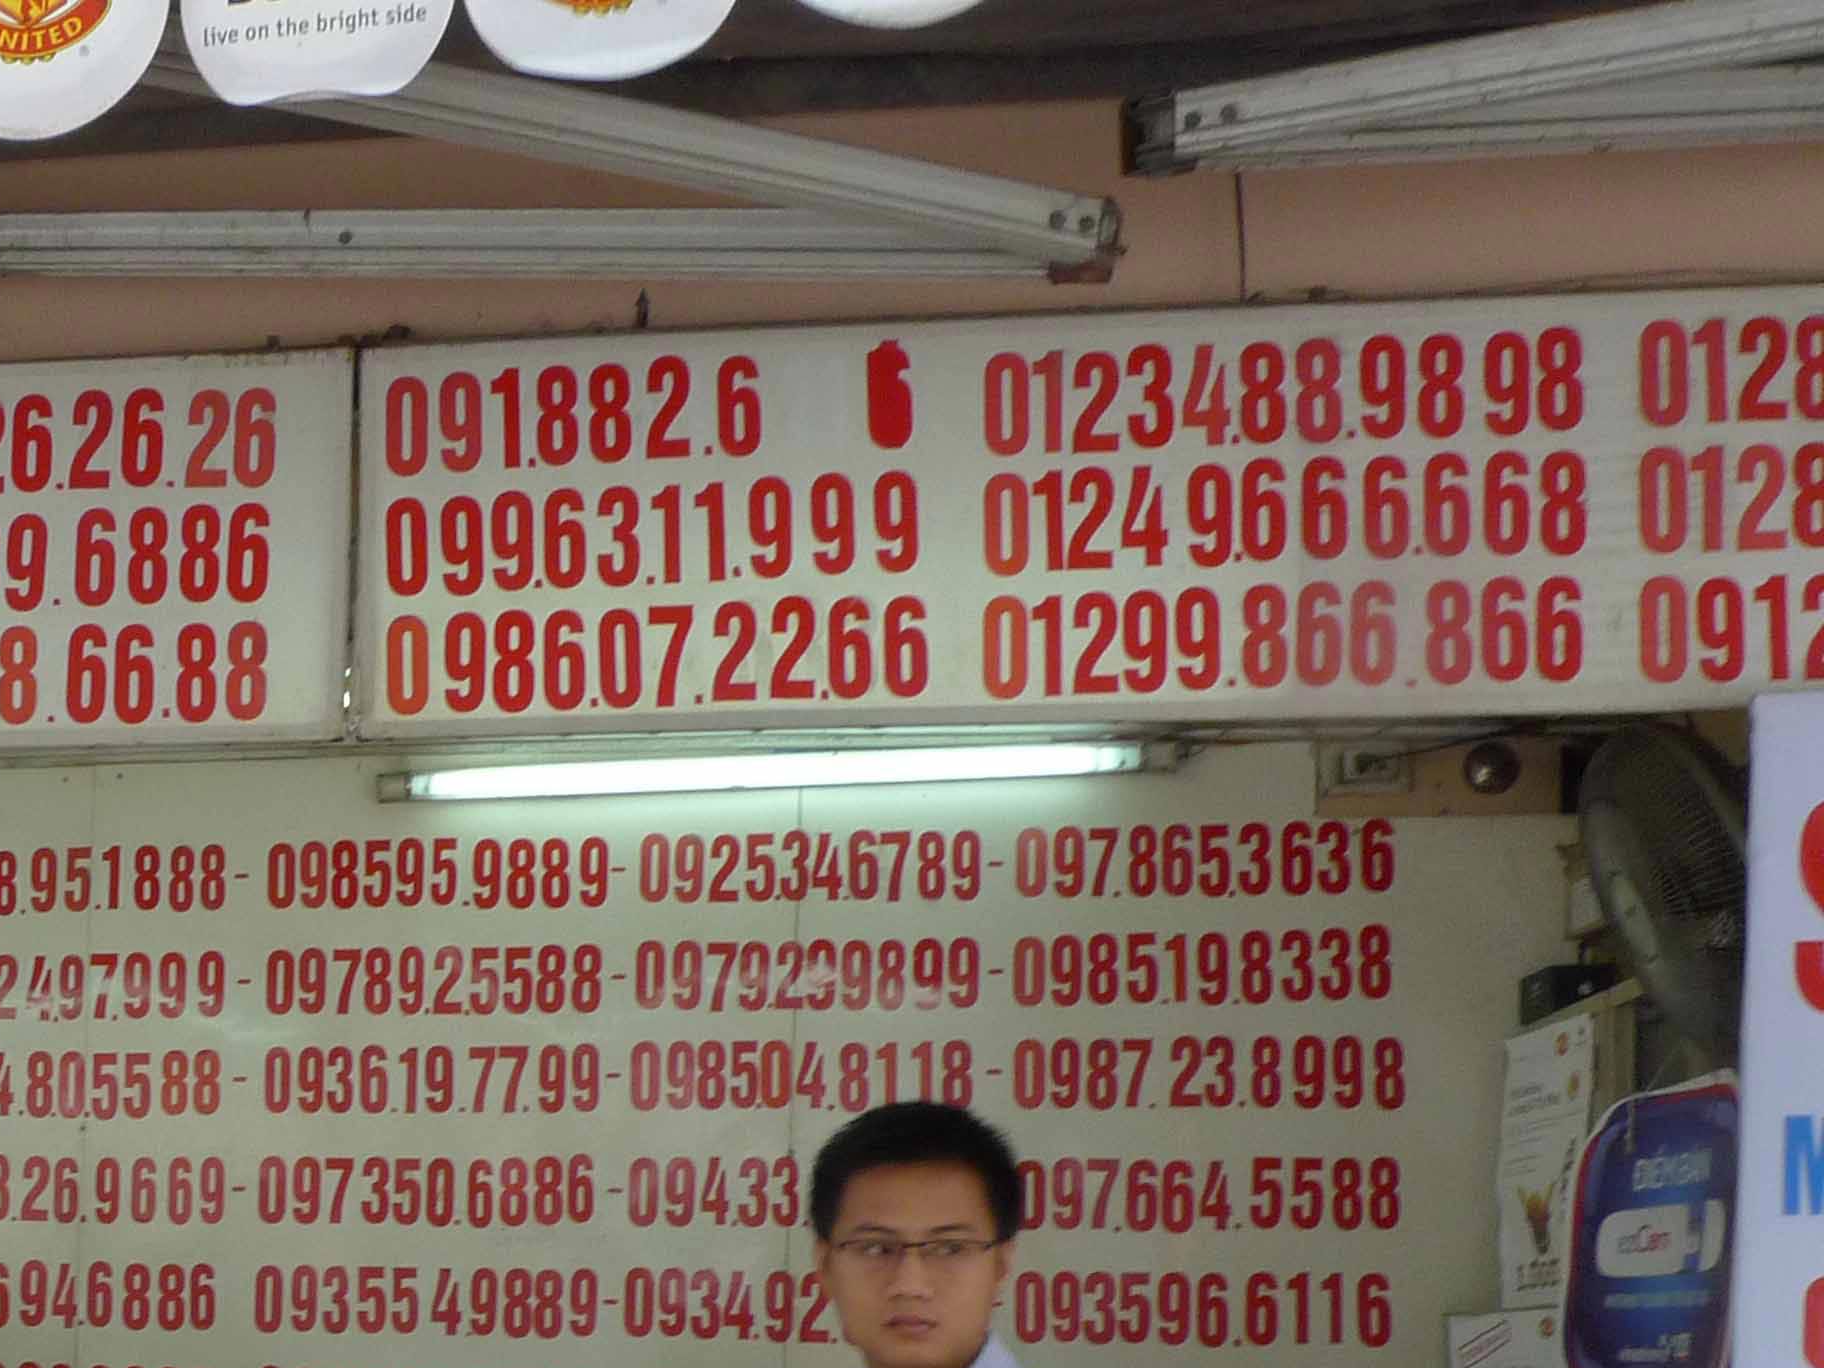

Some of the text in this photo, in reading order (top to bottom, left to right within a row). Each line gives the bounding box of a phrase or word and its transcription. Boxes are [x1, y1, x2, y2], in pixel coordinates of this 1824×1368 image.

[203, 3, 427, 47] live on the bright side
[386, 469, 920, 597] 099.63.11.999
[386, 595, 930, 716] 0986.07.22.66
[982, 576, 1584, 700] 01299.866.866
[267, 836, 608, 909] 098595.9889
[1014, 1270, 1392, 1348] 093596.6116
